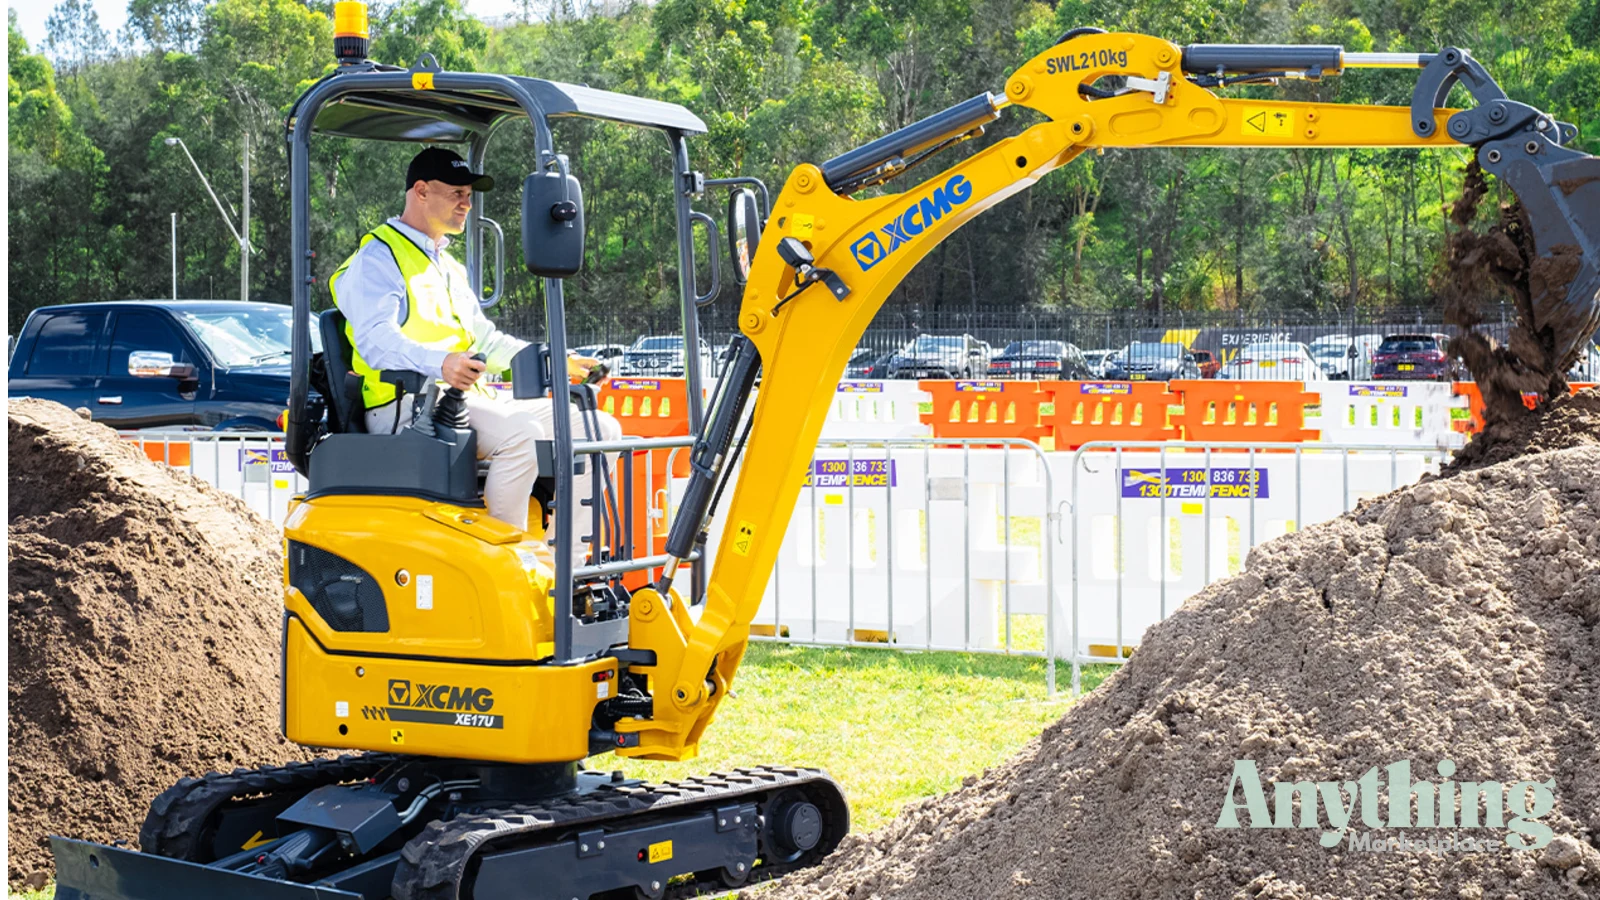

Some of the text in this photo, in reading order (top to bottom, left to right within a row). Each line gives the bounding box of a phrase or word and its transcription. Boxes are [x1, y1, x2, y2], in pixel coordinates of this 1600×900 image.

[1046, 49, 1128, 75] SWL210kg
[880, 174, 973, 255] XCMG
[1221, 332, 1293, 345] EXPERIENCE
[821, 461, 847, 473] 1300
[1213, 470, 1235, 482] 836
[411, 683, 494, 713] XCMG
[454, 713, 495, 728] XE17U
